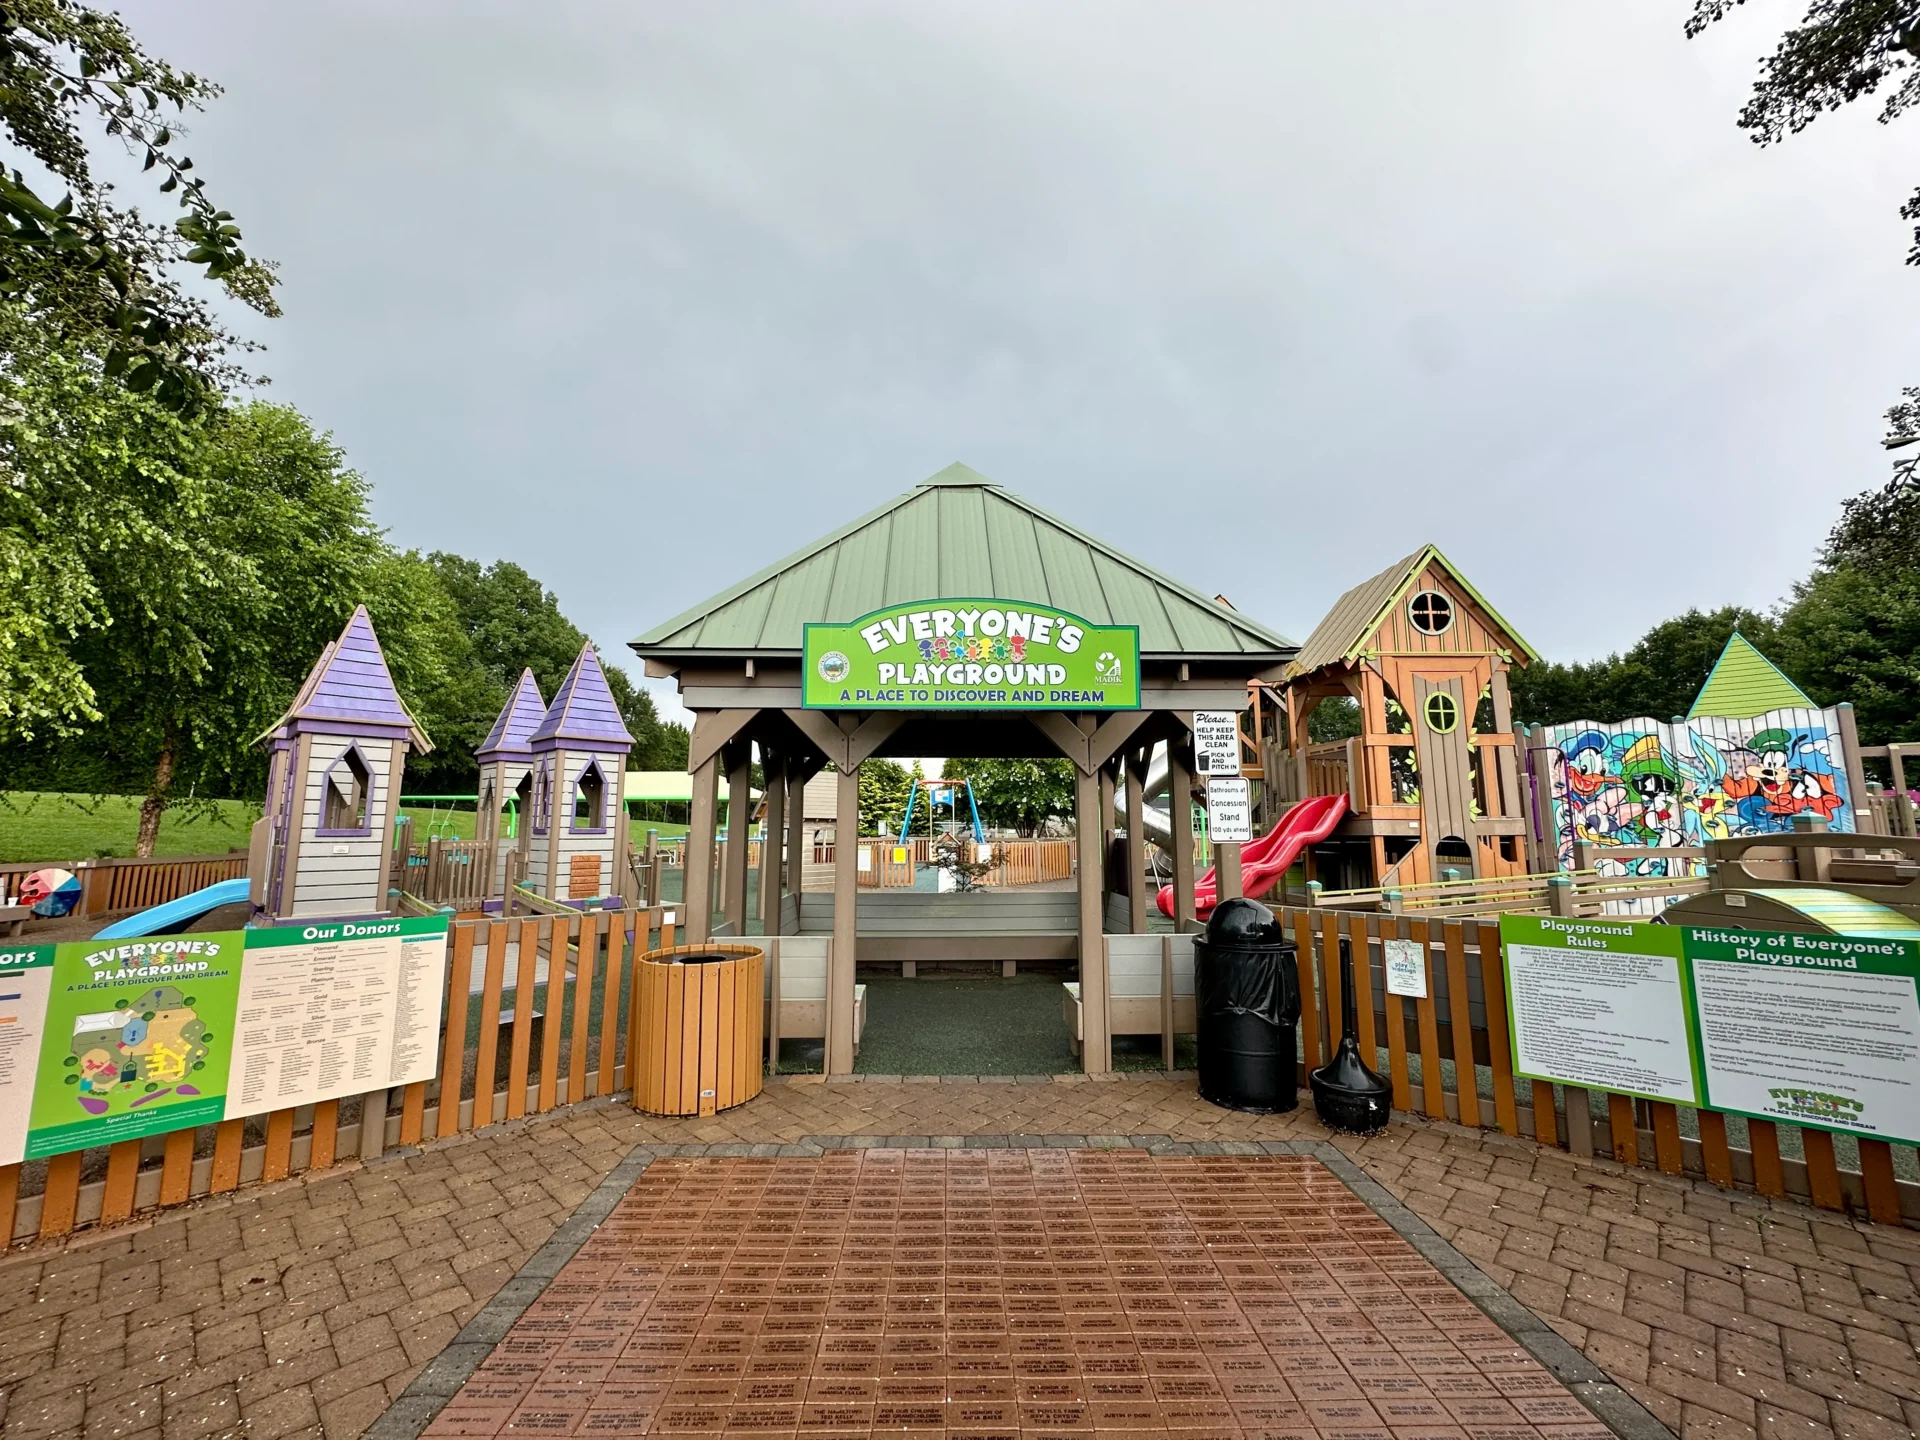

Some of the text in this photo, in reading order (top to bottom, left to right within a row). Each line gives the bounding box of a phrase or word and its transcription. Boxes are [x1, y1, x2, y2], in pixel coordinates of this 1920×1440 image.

[860, 608, 1085, 654] EVERYONE'S
[878, 662, 1067, 686] PLAYGROUND
[840, 690, 1104, 702] A PLACE TO DISCOVER AND DREAM
[303, 924, 400, 940] Our Donors
[1541, 920, 1633, 936] Playground
[1567, 936, 1607, 948] Rules
[1692, 930, 1905, 956] History of Everyone's
[84, 940, 220, 968] EVERYONE'S
[1736, 948, 1857, 968] Playground
[78, 982, 109, 991] PLACE
[128, 976, 172, 985] DISCOVER
[198, 970, 228, 979] DREAM
[93, 961, 209, 982] PLAYGROUND
[1583, 1078, 1616, 1087] emergency,
[1768, 1089, 1864, 1112] EVERYONE'S
[106, 1110, 157, 1124] Special Thanks
[1777, 1101, 1858, 1121] PLAYGROUND
[1801, 1114, 1832, 1122] DISCOVER
[1851, 1122, 1876, 1130] DREAM
